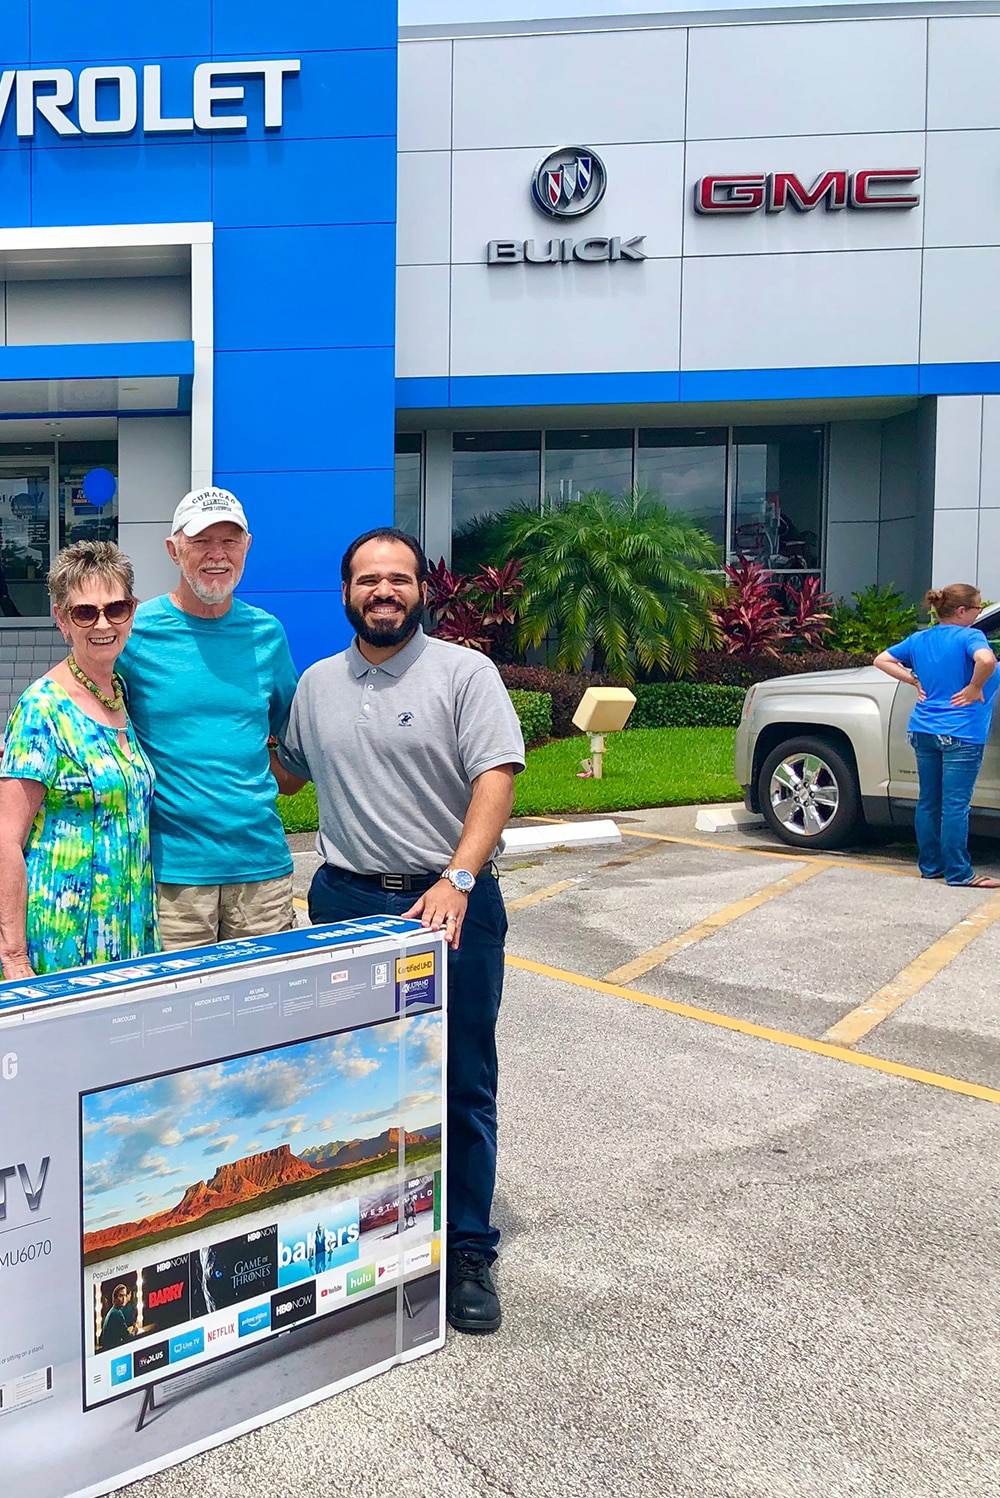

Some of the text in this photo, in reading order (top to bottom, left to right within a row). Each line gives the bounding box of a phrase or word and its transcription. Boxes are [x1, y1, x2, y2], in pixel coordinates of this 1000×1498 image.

[694, 166, 921, 215] GMC
[486, 235, 648, 265] BUICK
[230, 1265, 272, 1289] THRONES
[234, 1256, 262, 1275] GAME
[350, 1272, 372, 1289] hulu
[147, 1281, 185, 1309] BARRY
[207, 1322, 236, 1343] NETFLIX
